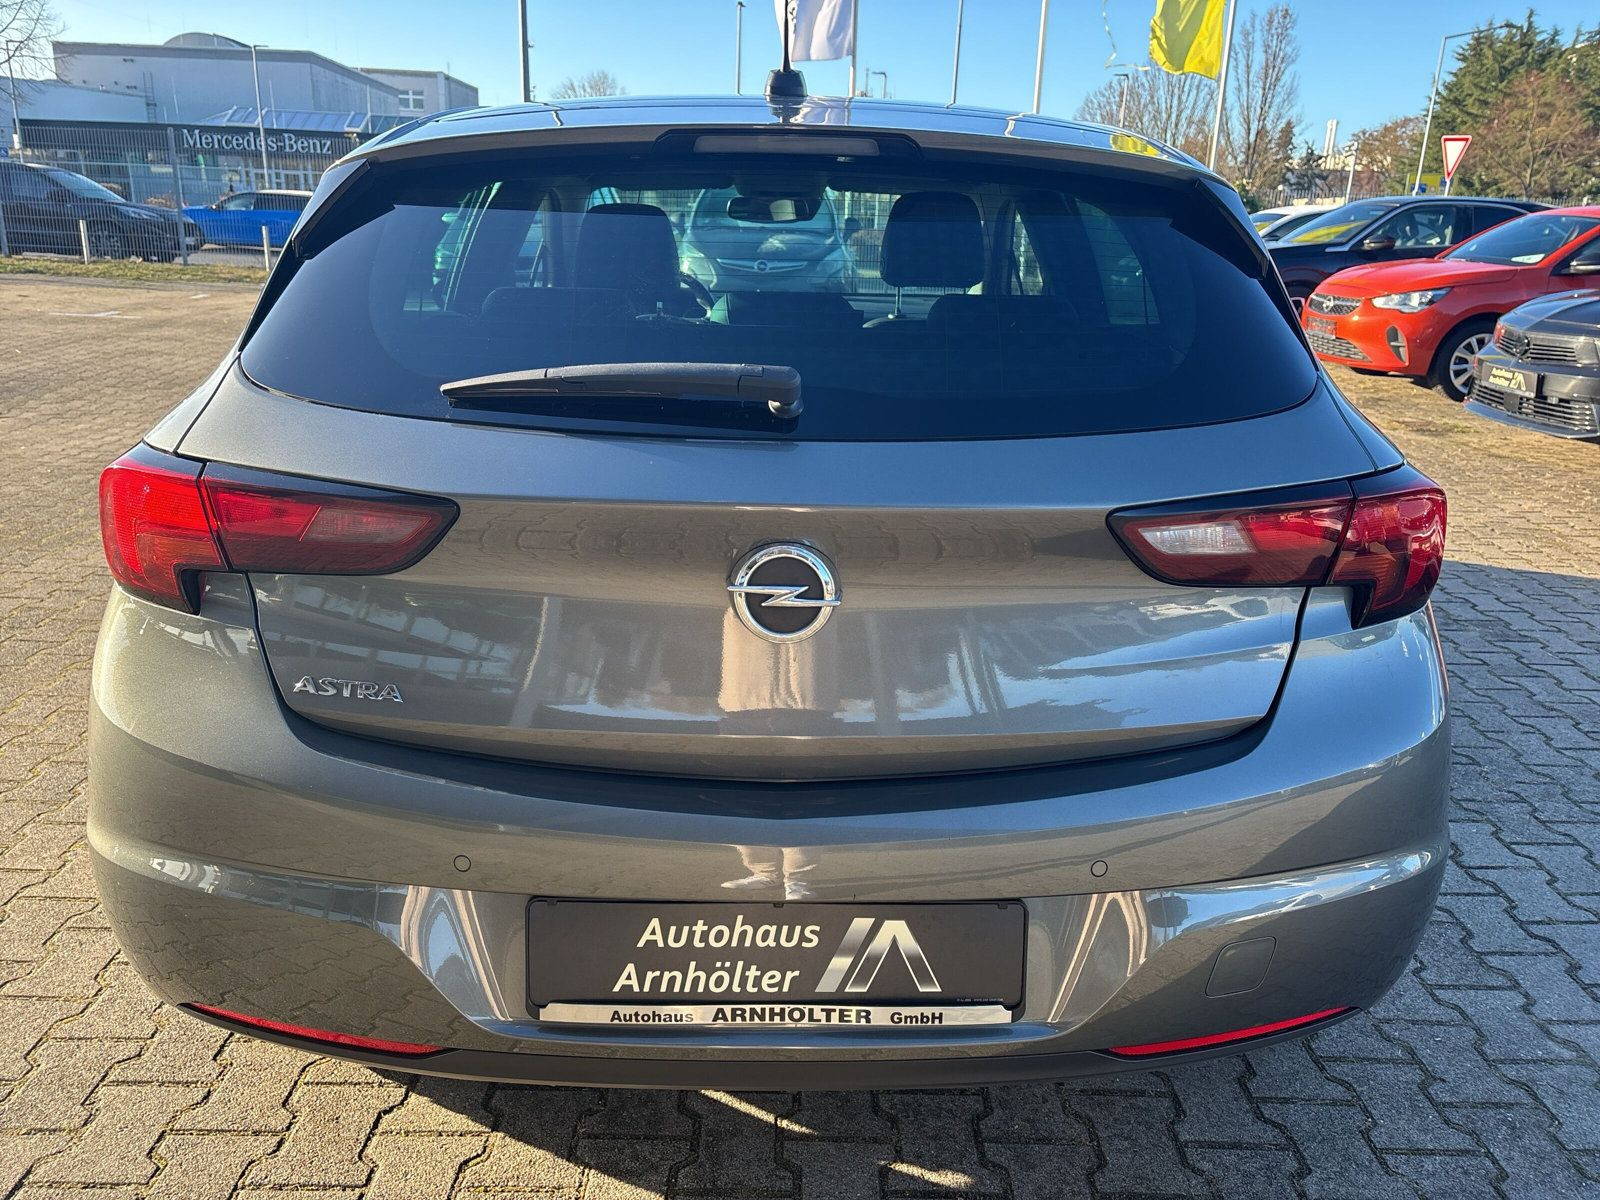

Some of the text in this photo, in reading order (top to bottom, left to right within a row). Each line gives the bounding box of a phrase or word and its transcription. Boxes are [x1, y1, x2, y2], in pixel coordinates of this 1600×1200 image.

[181, 129, 332, 154] Mercedes-Benz
[293, 675, 404, 703] ASTRA
[636, 915, 821, 948] Autohaus
[612, 961, 800, 993] Arnhölter
[610, 1006, 943, 1025] Autohaus ARNHÖLTER GmbH
